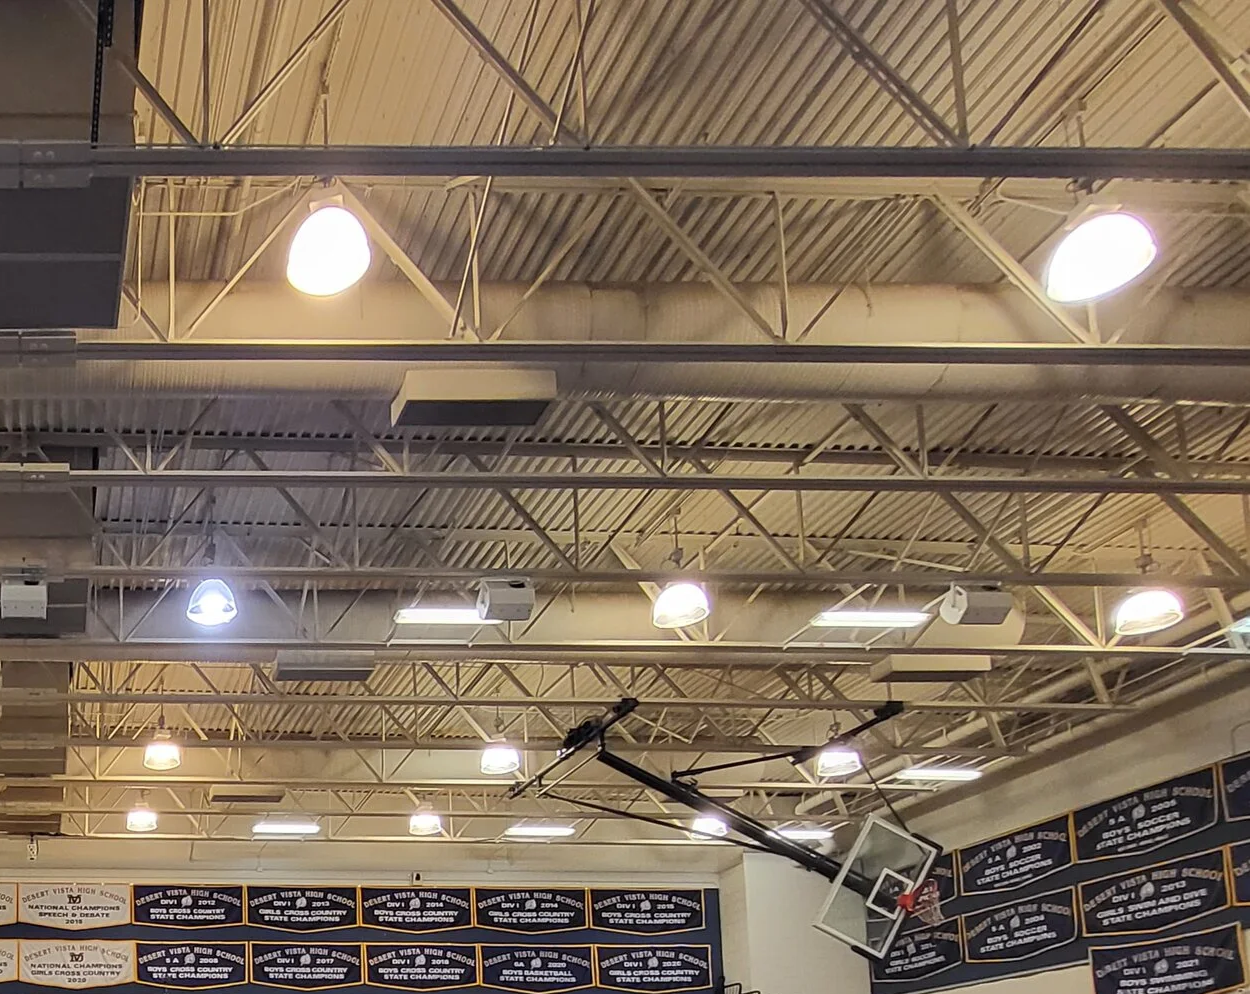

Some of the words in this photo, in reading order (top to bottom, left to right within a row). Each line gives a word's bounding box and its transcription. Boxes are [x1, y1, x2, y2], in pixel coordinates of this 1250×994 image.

[1077, 810, 1108, 838] DESERT
[1112, 796, 1139, 812] VISTA
[1143, 789, 1168, 801] HIGH
[1172, 787, 1212, 798] SCHOOL
[1095, 836, 1124, 850] STATE
[1126, 817, 1191, 841] CHAMPIONS
[1102, 826, 1131, 839] BOYS
[1137, 812, 1180, 829] SOCCER
[22, 890, 49, 903] DESERT
[100, 890, 126, 904] SCHOOL
[135, 892, 163, 906] DESERT
[213, 893, 241, 906] SCHOOL
[1083, 886, 1117, 912] DESERT
[1119, 874, 1147, 890] VISTA
[1152, 869, 1176, 880] HIGH
[1181, 868, 1223, 881] SCHOOL
[364, 895, 390, 908] DESERT
[441, 895, 469, 909] SCHOOL
[1096, 907, 1124, 918] GIRLS
[1158, 895, 1181, 905] AND
[1183, 888, 1208, 900] DIVE
[1102, 914, 1132, 926] STATE
[1134, 900, 1201, 919] CHAMPIONS
[24, 948, 51, 962] DESERT
[101, 948, 129, 962] SCHOOL
[484, 954, 511, 967] DESERT
[562, 954, 590, 968] SCHOOL
[1131, 950, 1160, 963] VISTA
[1164, 945, 1190, 956] HIGH
[1119, 978, 1147, 987] BOYS
[1149, 969, 1208, 984] SWIMMING
[1147, 977, 1215, 994] CHAMPIONS
